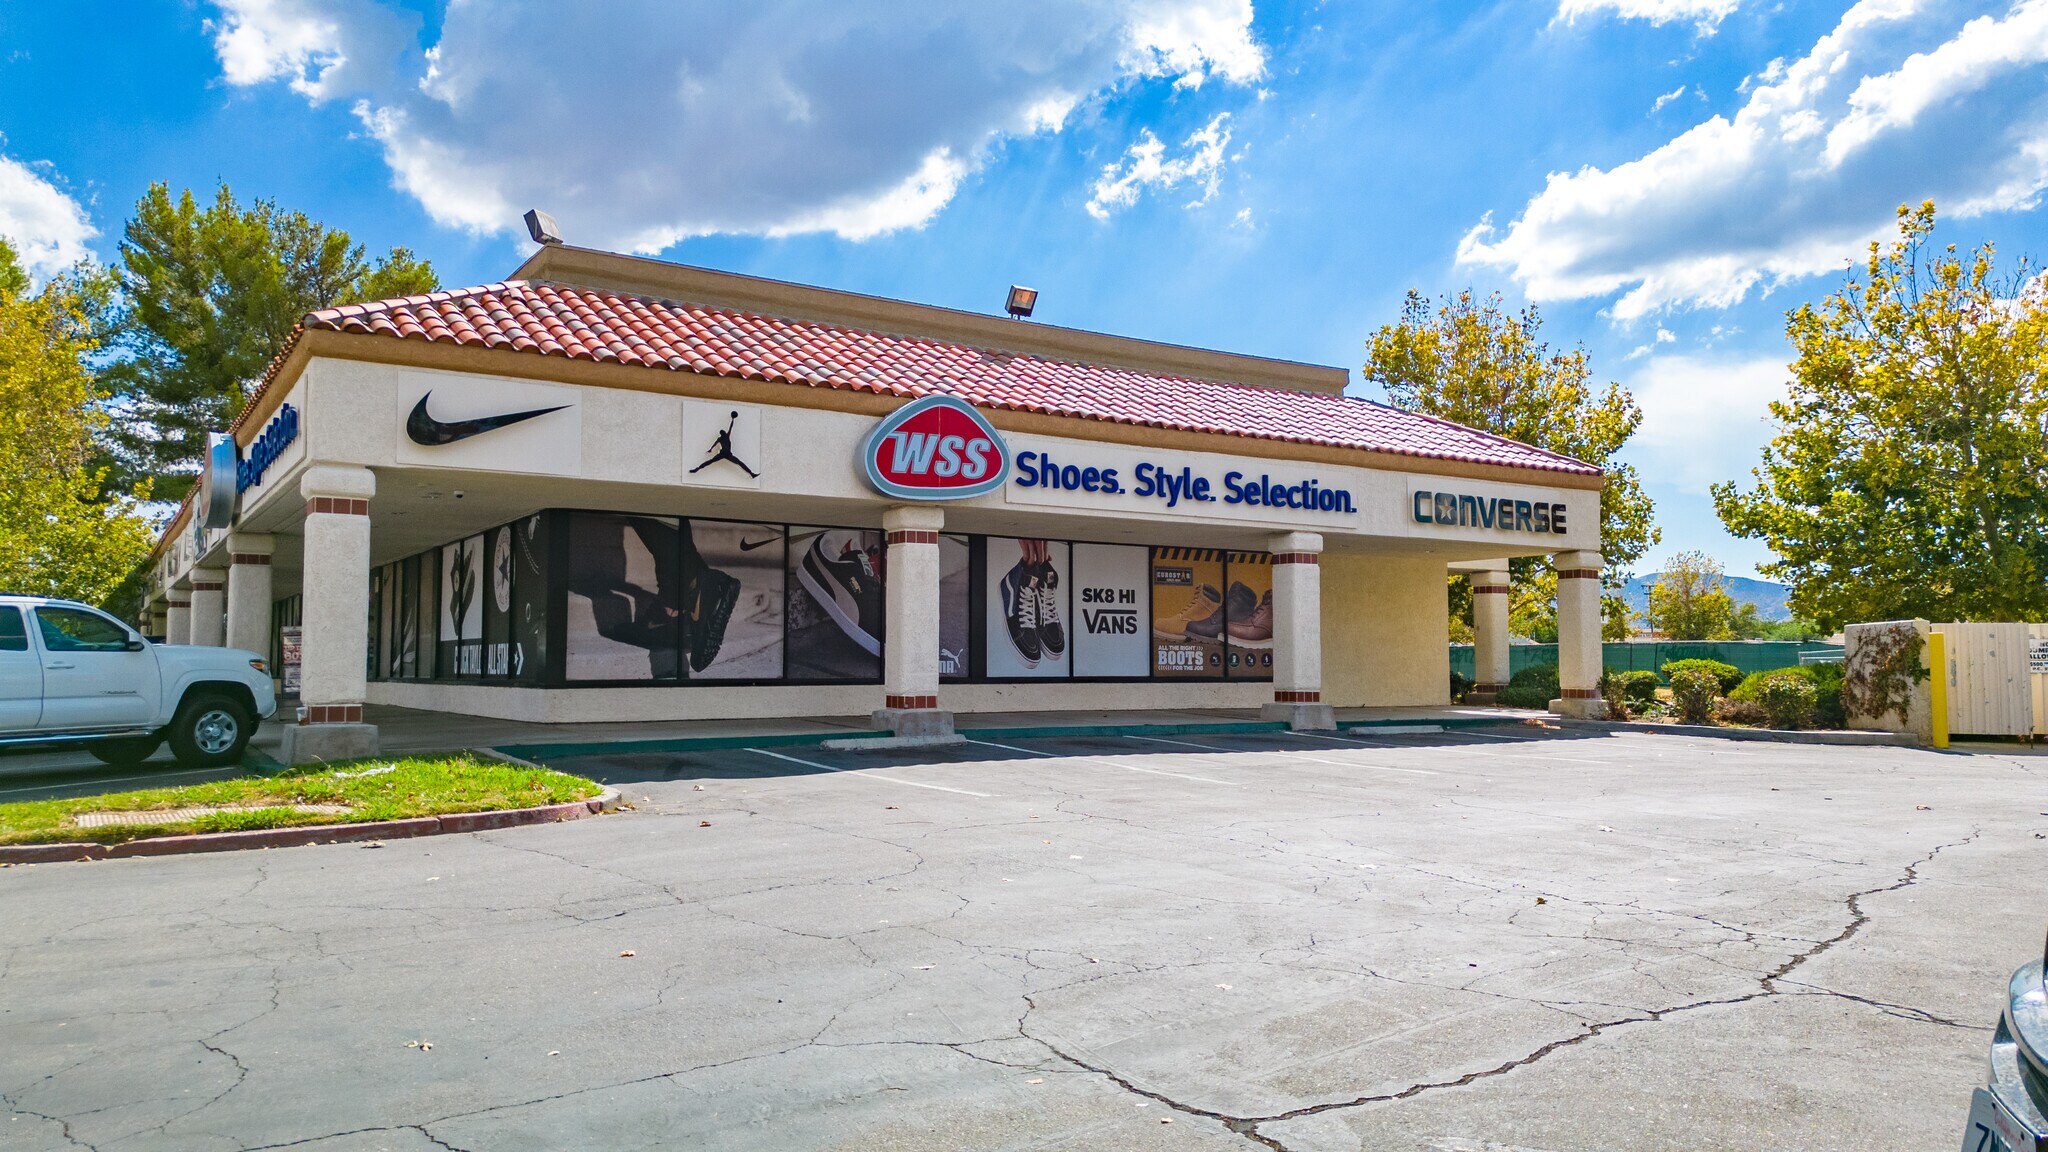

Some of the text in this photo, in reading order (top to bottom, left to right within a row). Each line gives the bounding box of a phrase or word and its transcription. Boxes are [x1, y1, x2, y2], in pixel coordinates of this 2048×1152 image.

[889, 431, 991, 479] WSS
[1015, 451, 1357, 513] Shoes. Style. Selection.
[1414, 490, 1567, 535] CONVERSE
[1082, 588, 1135, 604] SK8 HI
[1082, 609, 1137, 635] VANS
[284, 651, 302, 661] 60
[1158, 651, 1204, 666] BOOTS
